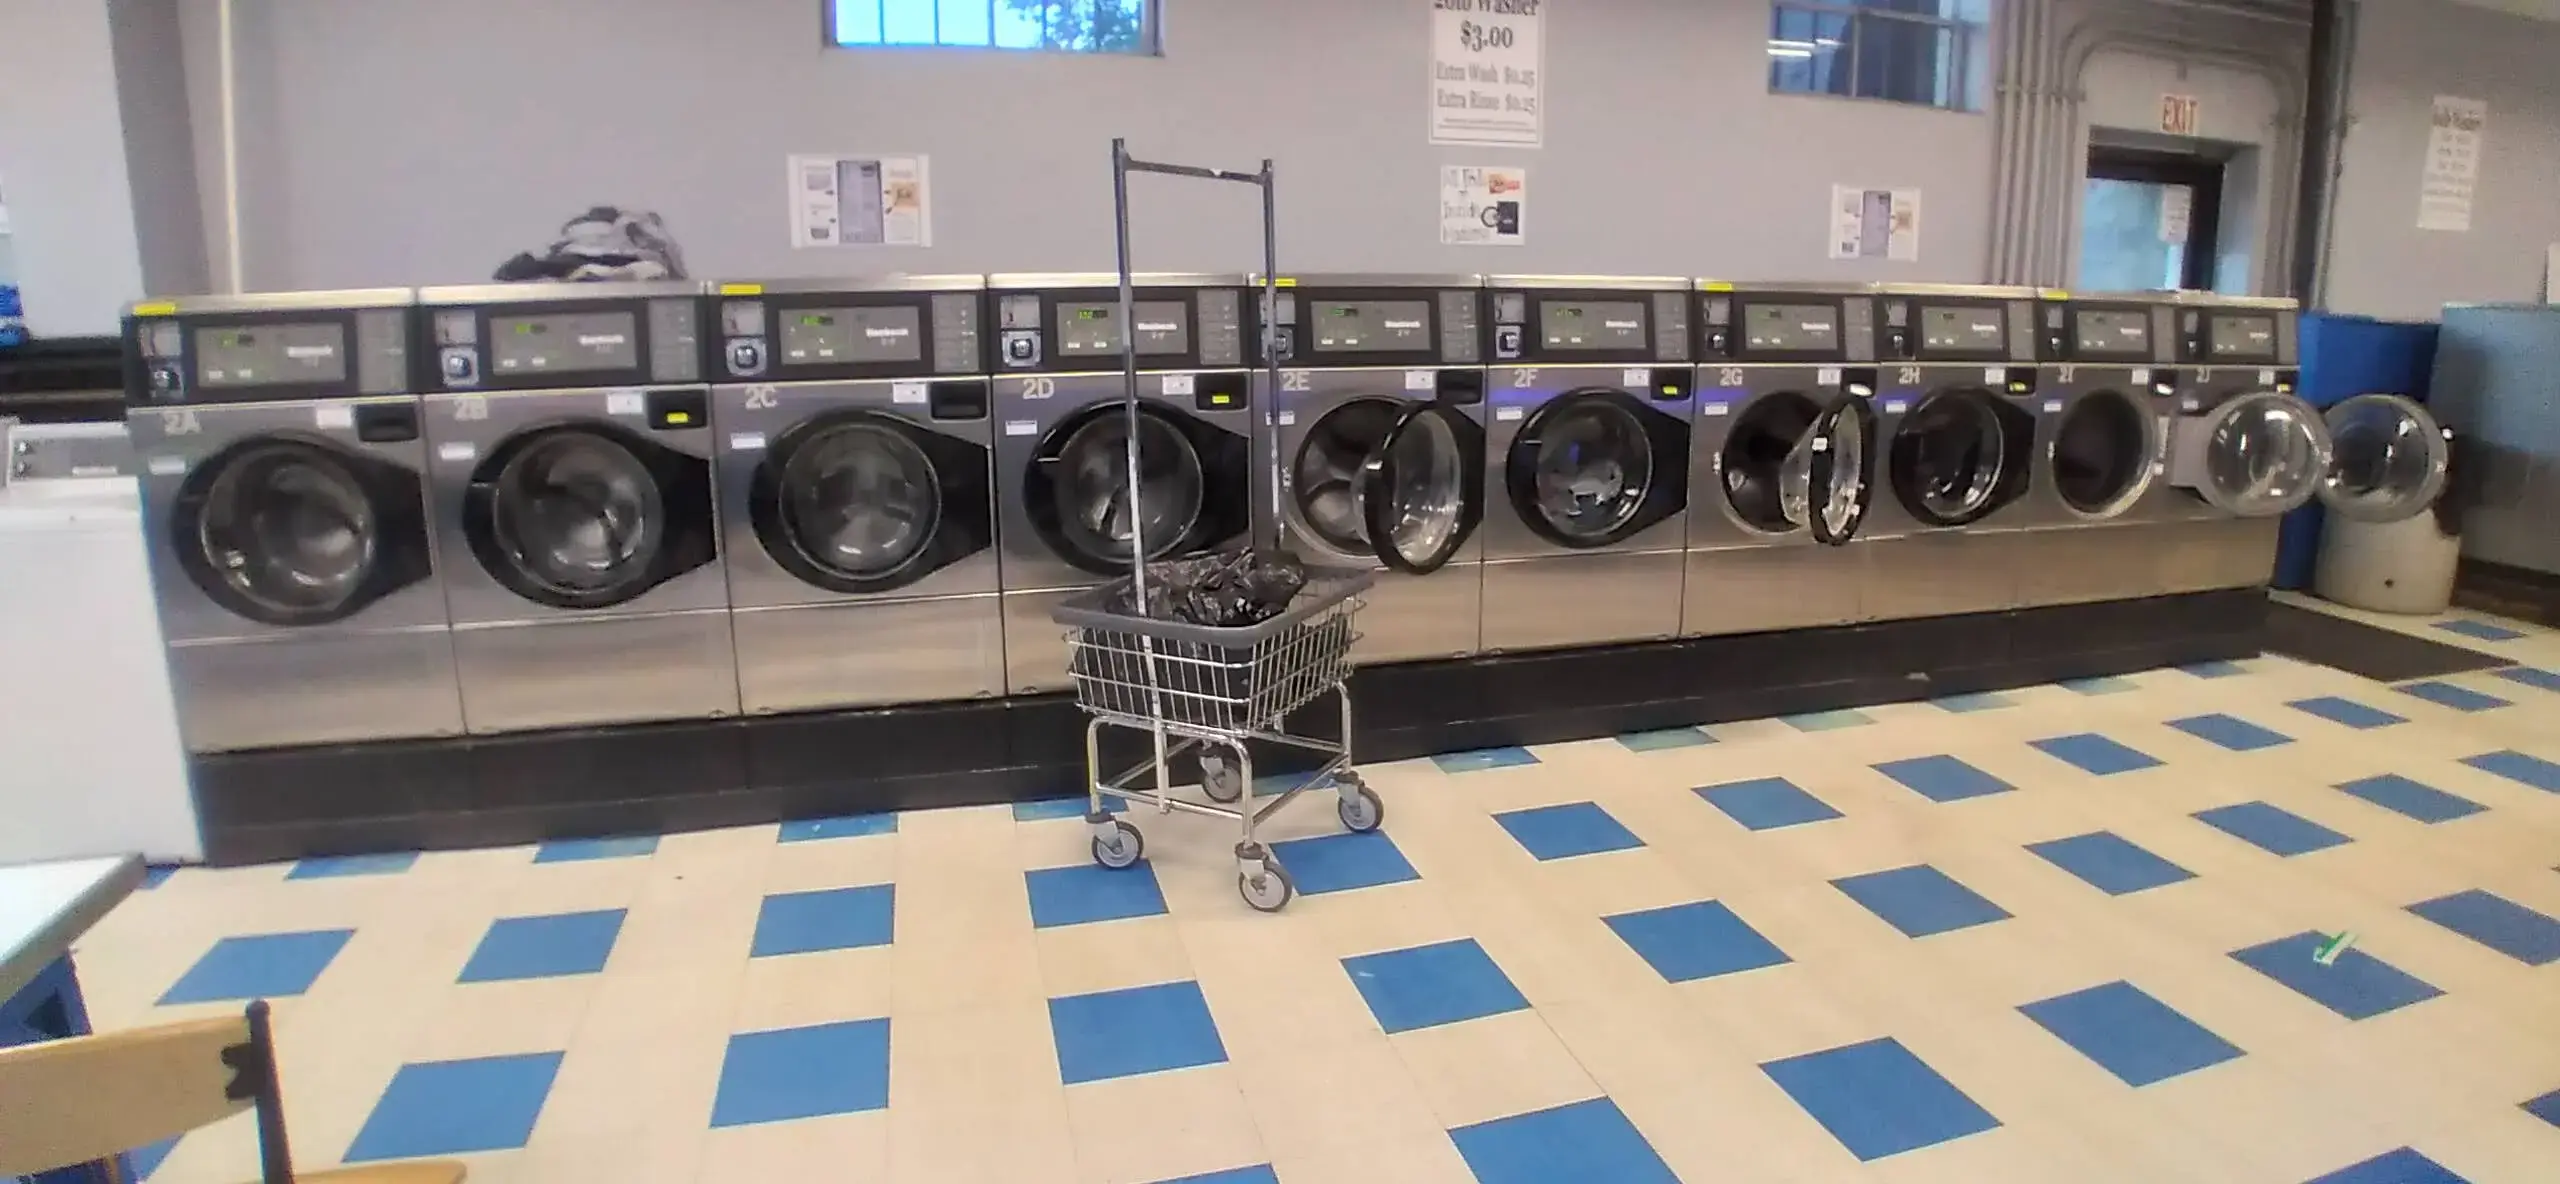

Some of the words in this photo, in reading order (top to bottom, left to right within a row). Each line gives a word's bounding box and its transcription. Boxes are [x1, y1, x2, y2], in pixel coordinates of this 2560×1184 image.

[1460, 19, 1514, 52] $3.00
[2161, 96, 2197, 135] EXIT
[1281, 372, 1312, 392] 2E
[1513, 368, 1538, 388] 2F
[1719, 368, 1744, 387] 2G
[1899, 367, 1921, 385] 2H
[744, 385, 778, 410] 2C
[1022, 378, 1055, 399] 2D
